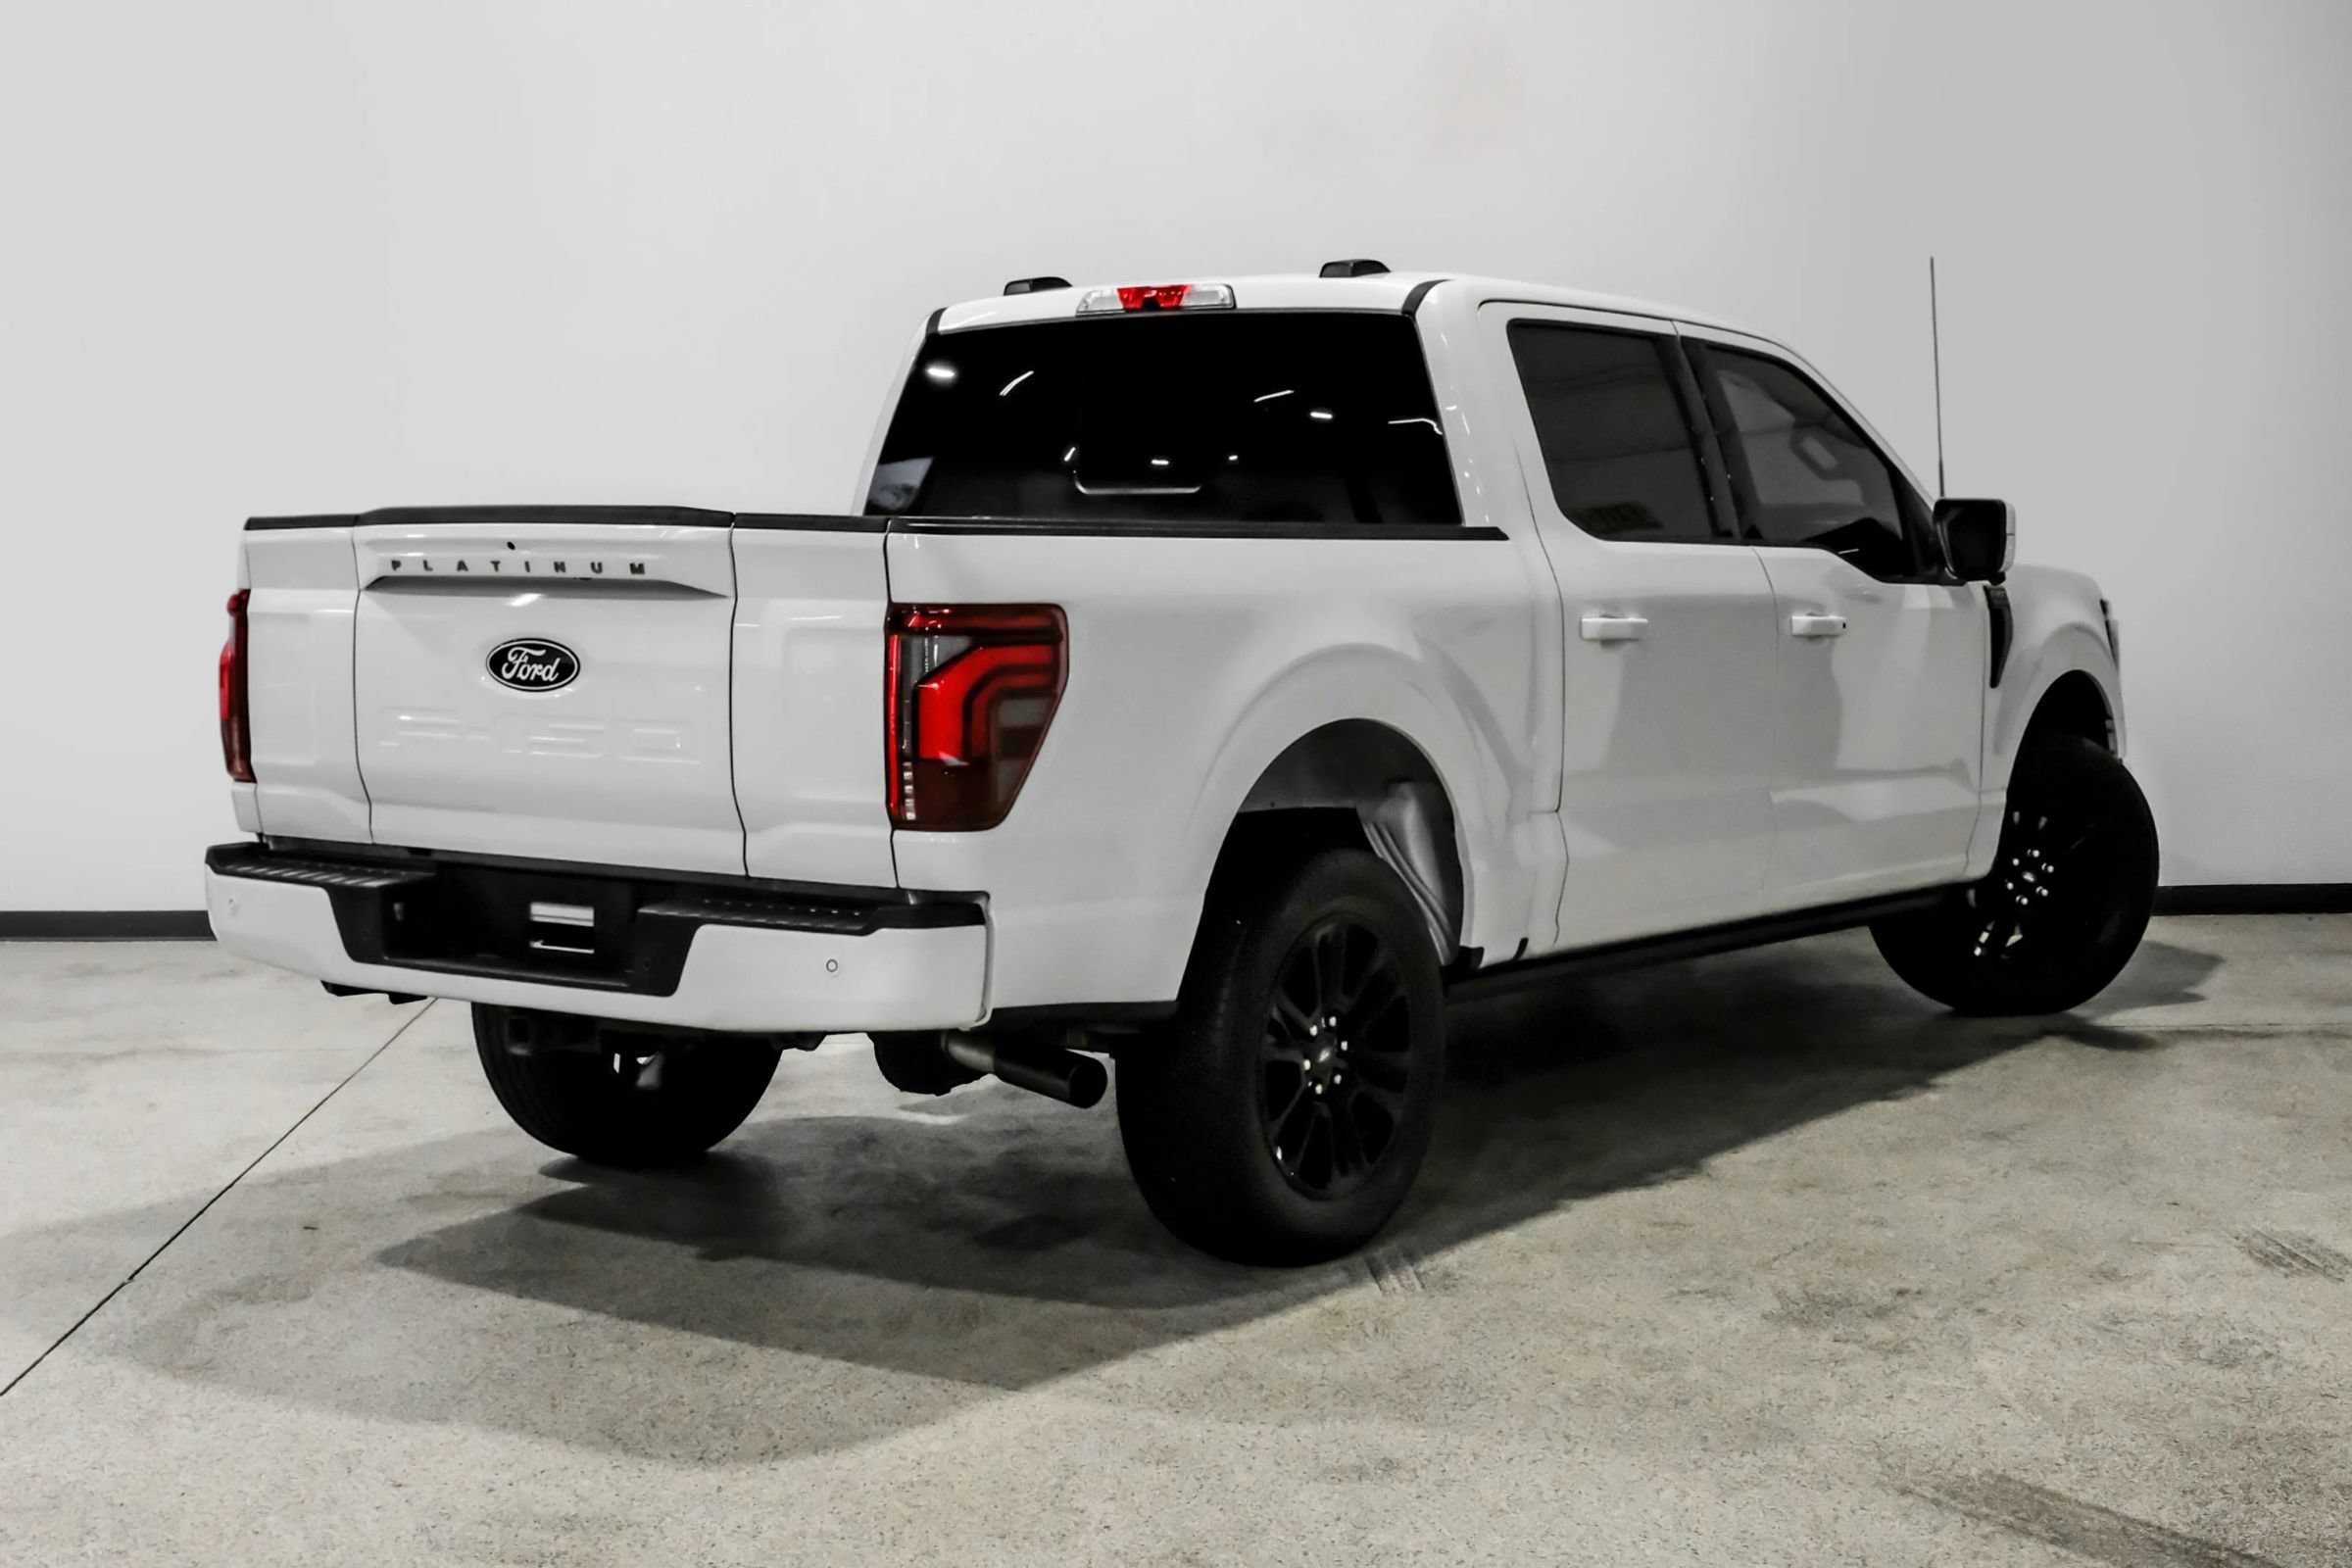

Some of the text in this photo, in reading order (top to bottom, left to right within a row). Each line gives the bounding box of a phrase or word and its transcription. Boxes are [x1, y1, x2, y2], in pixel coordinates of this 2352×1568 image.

[391, 560, 646, 575] PLATINUM
[501, 646, 562, 682] Ford
[378, 705, 701, 764] F-150
